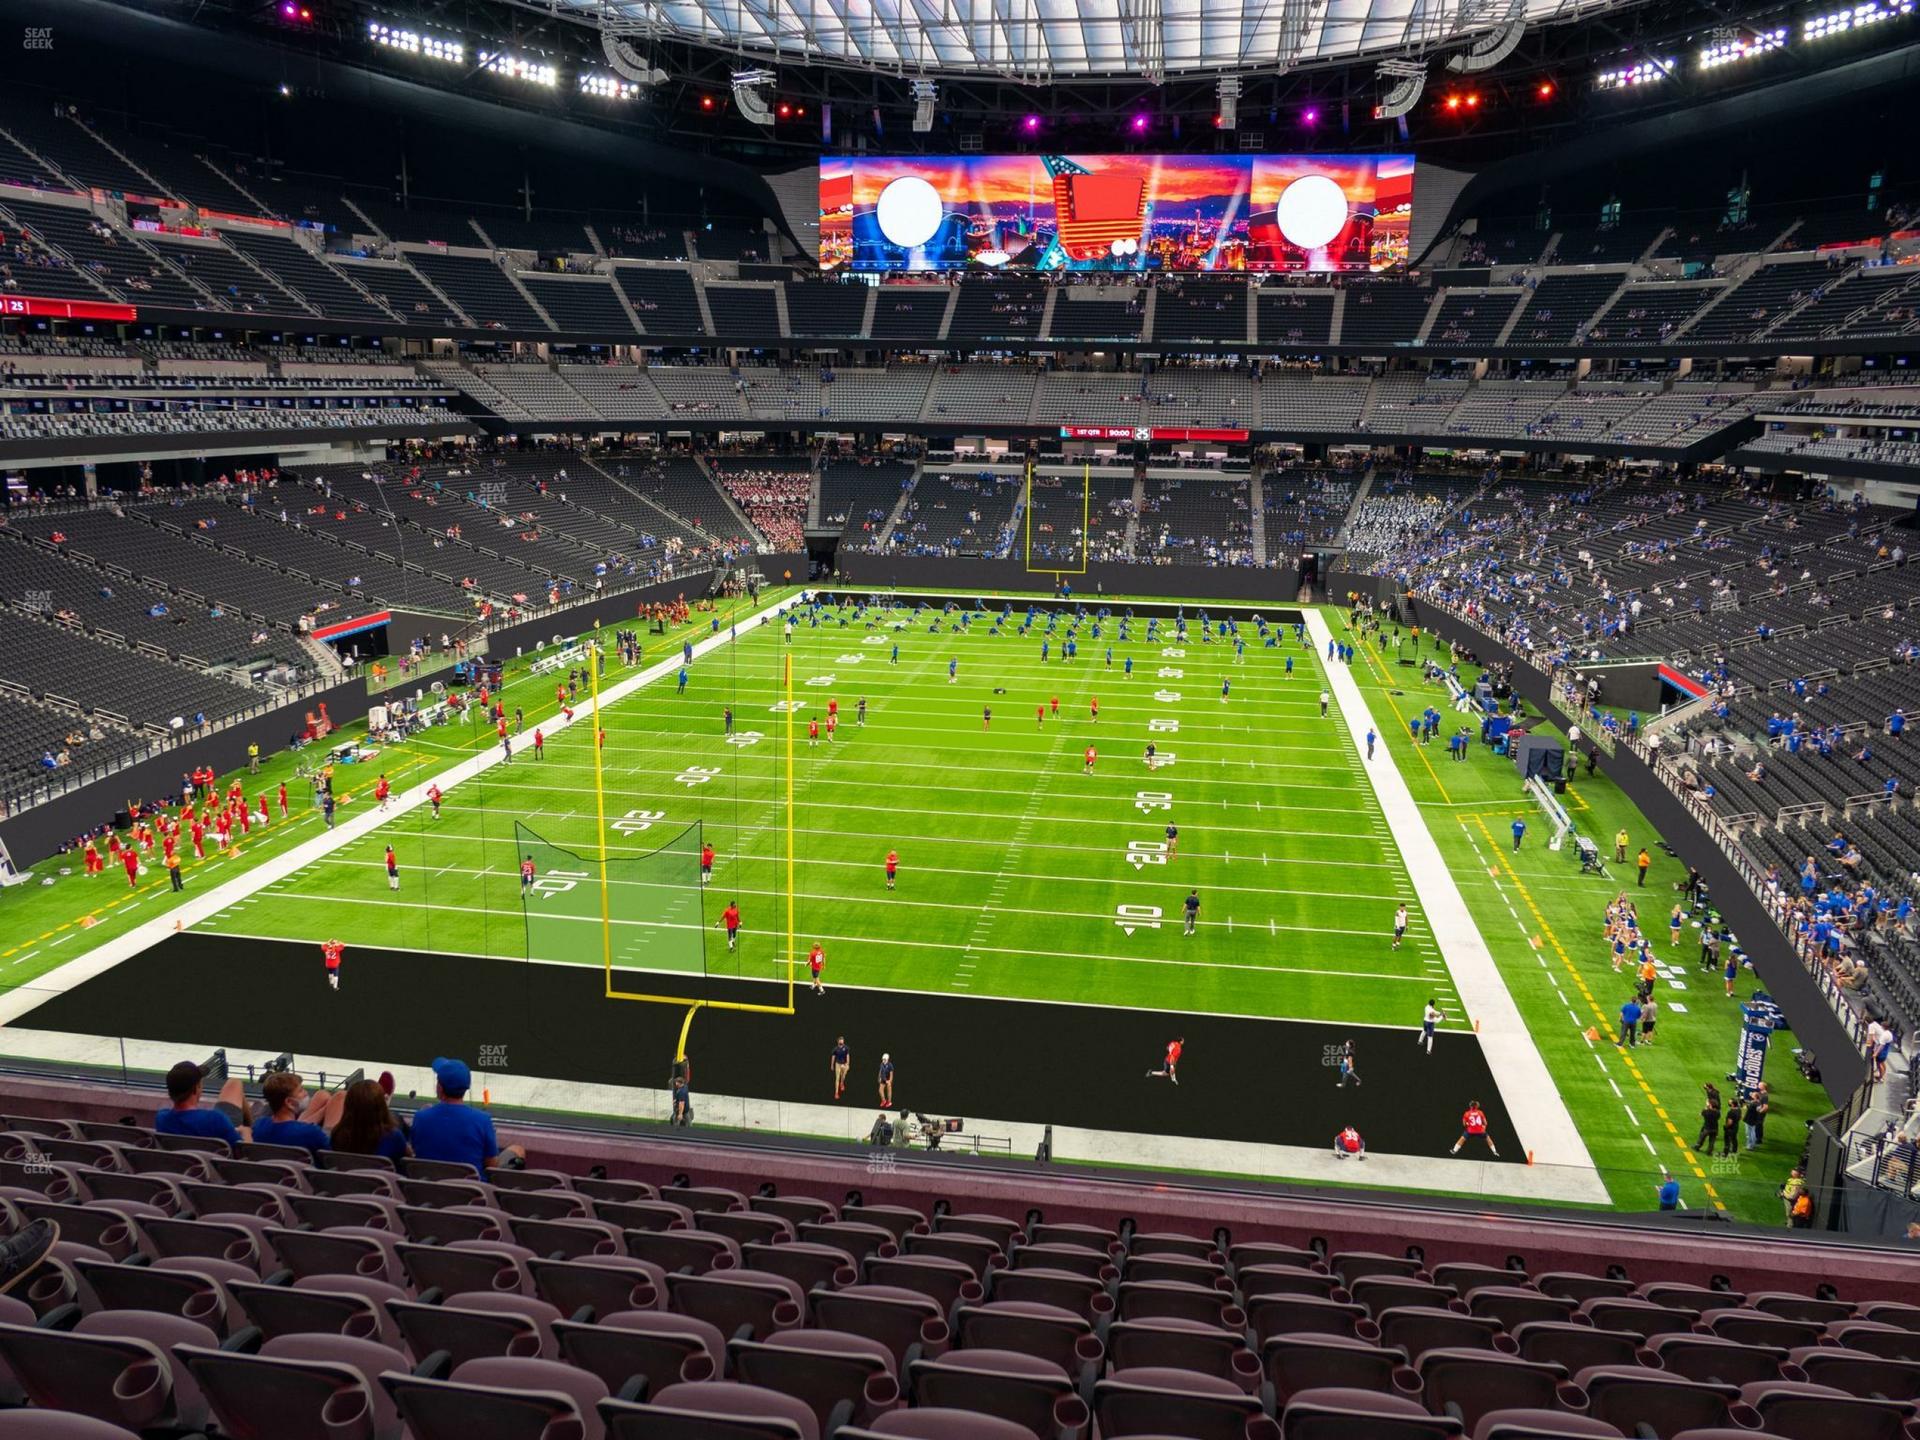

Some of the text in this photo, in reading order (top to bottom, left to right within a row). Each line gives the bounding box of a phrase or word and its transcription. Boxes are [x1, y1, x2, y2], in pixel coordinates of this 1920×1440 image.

[10, 301, 24, 311] 25
[1108, 429, 1130, 437] 90:00
[1135, 428, 1149, 439] 25
[1148, 719, 1180, 732] 50
[674, 766, 722, 783] 30
[1135, 791, 1173, 810] 30
[611, 809, 666, 831] 20
[1126, 841, 1168, 865] 20
[532, 870, 590, 891] 10
[1114, 904, 1163, 929] 10
[1746, 1049, 1763, 1078] COUGS
[1743, 1076, 1759, 1089] GO
[1469, 1115, 1483, 1126] 34
